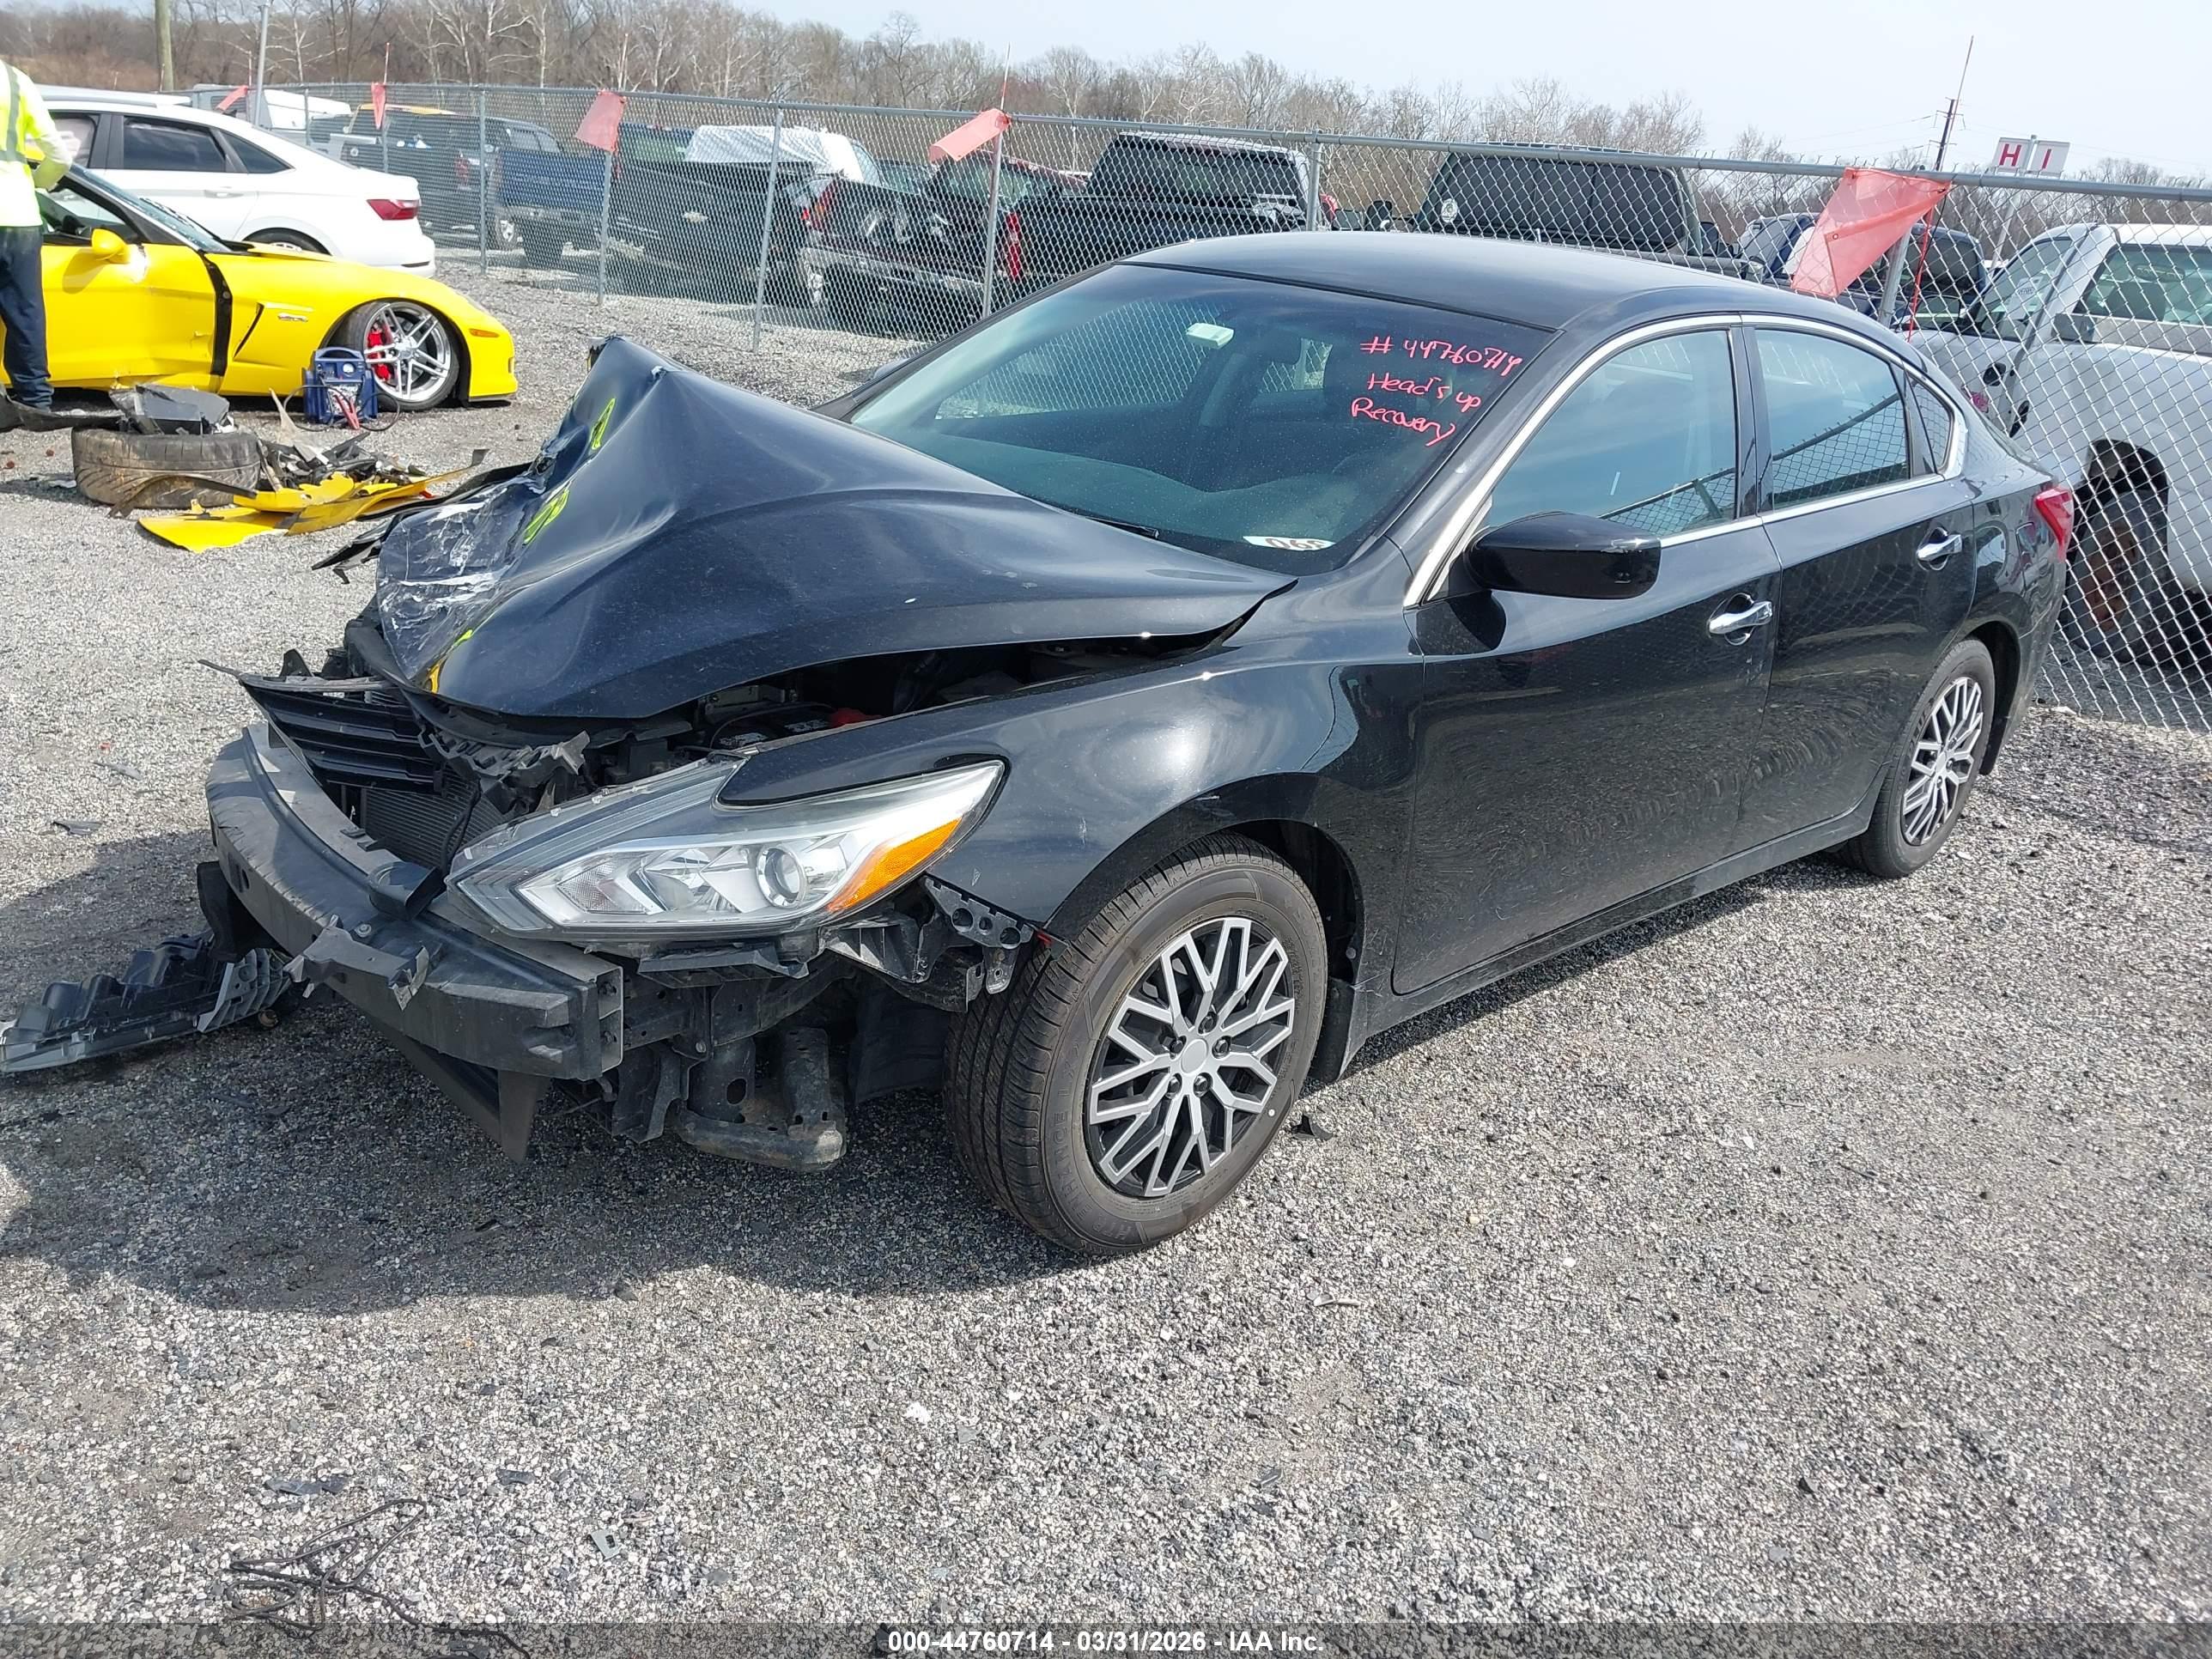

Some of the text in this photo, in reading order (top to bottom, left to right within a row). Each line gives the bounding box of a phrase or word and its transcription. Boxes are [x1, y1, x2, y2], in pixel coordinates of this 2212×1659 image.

[1999, 143, 2052, 169] H I
[1360, 336, 1395, 354] #
[1352, 398, 1456, 447] Recovery
[1052, 1110, 1093, 1224] ENHANCE
